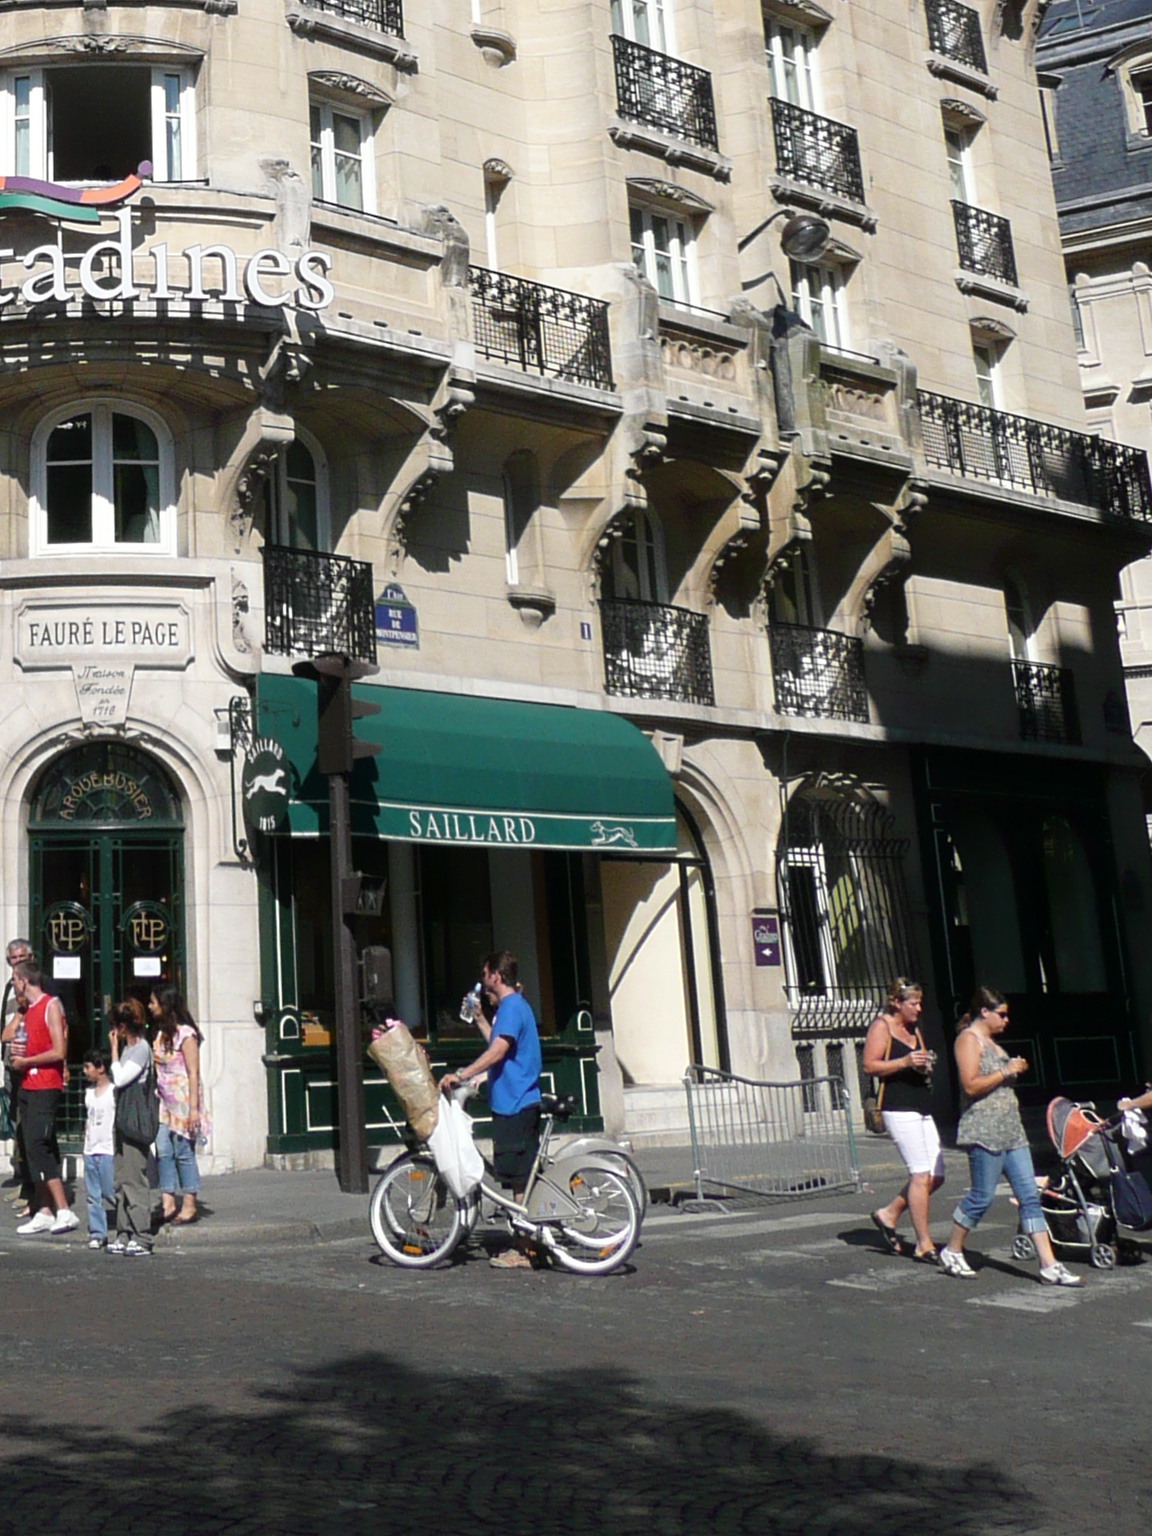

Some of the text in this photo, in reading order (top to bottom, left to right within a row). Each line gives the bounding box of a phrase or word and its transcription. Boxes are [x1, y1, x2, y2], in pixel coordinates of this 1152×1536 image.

[388, 609, 402, 619] RUE
[391, 620, 401, 629] DE
[29, 617, 179, 646] FAURÉ LE PAGE
[78, 666, 124, 678] Maison
[79, 683, 125, 695] Fondée
[248, 738, 283, 764] SAILLARD
[409, 811, 535, 843] SAILLARD
